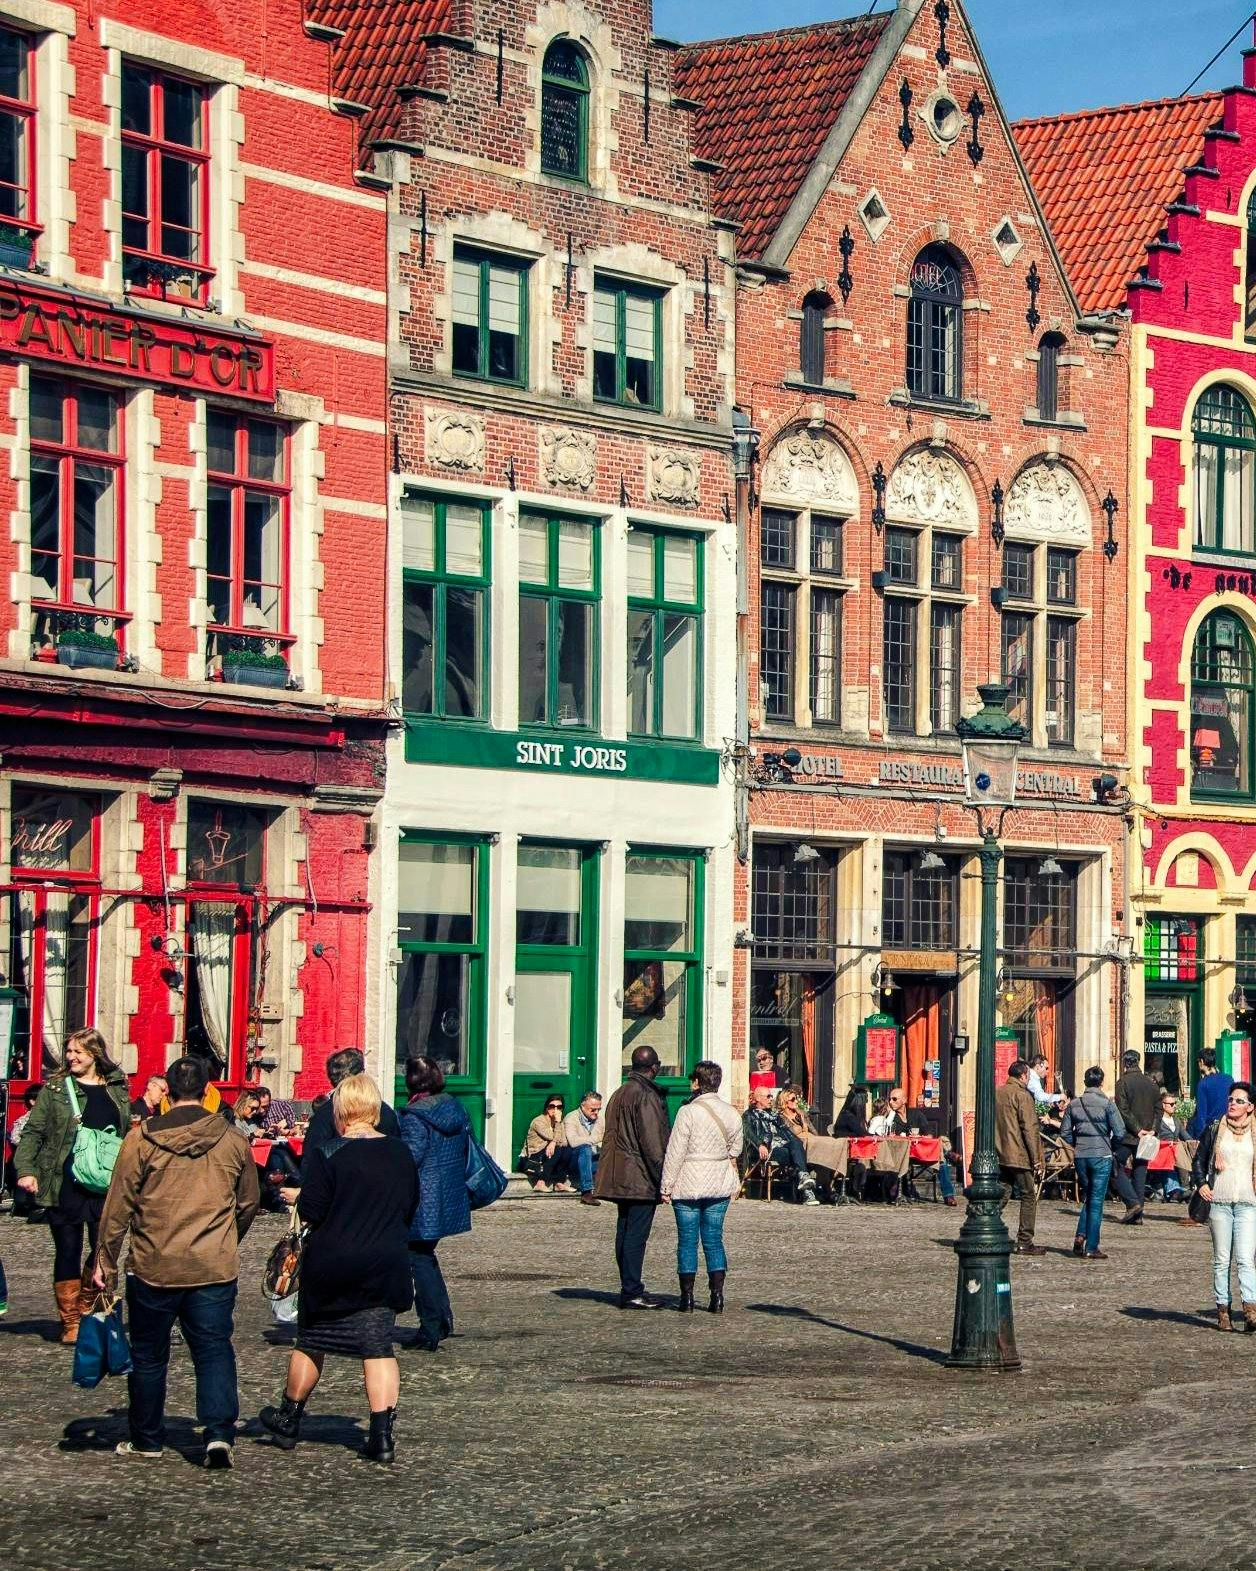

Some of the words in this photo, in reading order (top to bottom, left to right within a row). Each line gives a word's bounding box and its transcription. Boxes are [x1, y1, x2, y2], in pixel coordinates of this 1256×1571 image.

[170, 338, 263, 392] D'OR
[516, 741, 564, 766] SINT
[570, 746, 627, 772] JORIS
